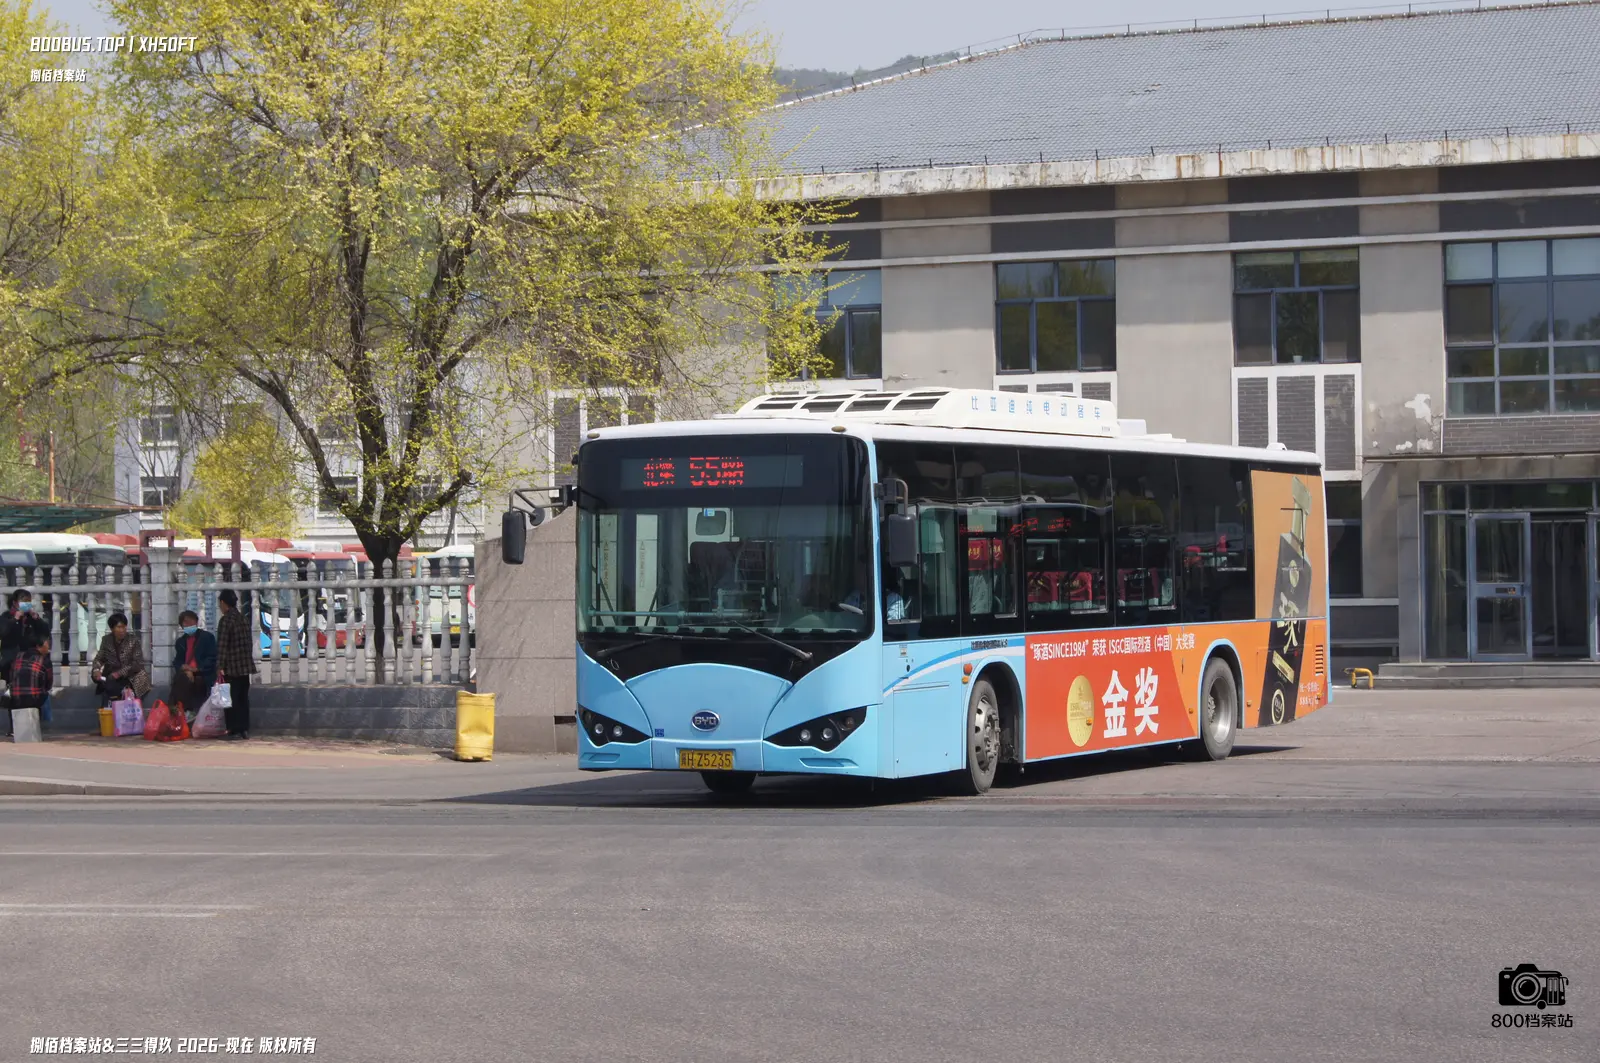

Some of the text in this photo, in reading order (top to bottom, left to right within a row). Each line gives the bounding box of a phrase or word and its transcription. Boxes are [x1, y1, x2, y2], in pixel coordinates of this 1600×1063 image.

[1092, 639, 1107, 656] 荣获
[1175, 633, 1195, 650] 大奖赛
[1101, 666, 1159, 739] 金奖
[694, 716, 717, 726] BYD
